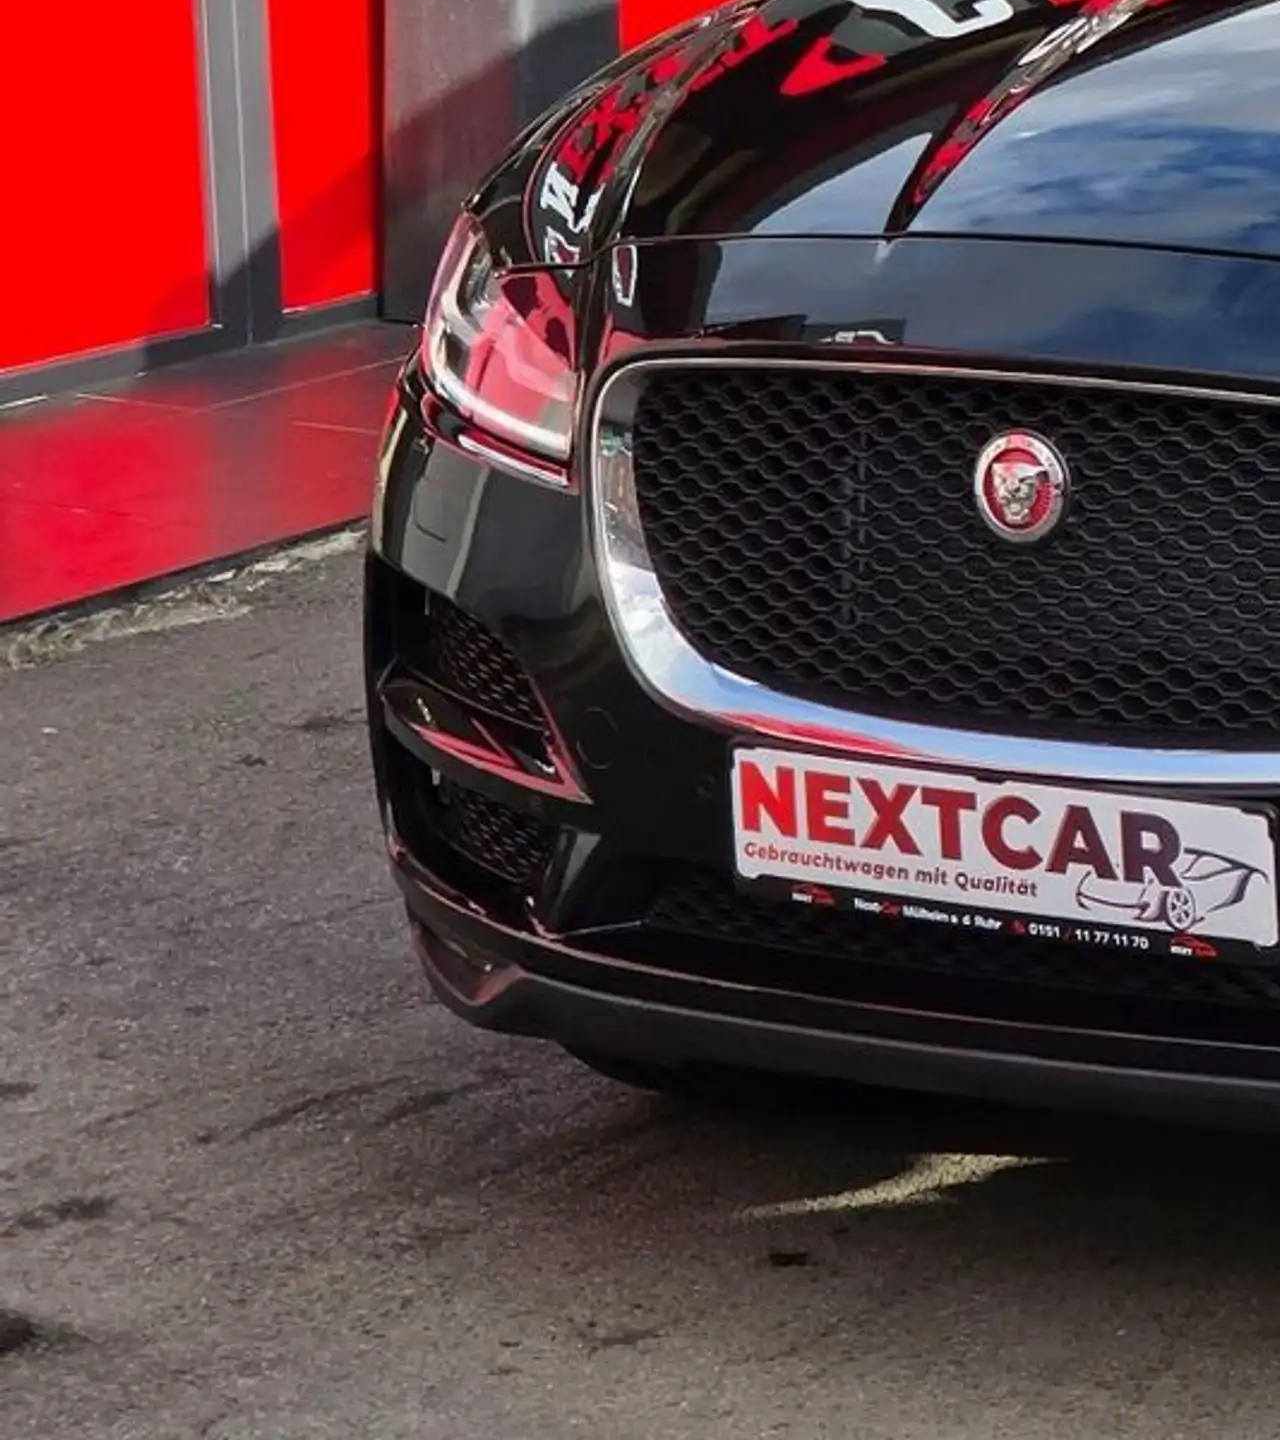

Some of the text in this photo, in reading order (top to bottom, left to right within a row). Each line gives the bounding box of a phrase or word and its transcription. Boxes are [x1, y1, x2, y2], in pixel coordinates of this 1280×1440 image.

[739, 760, 1184, 888] NEXTCAR
[743, 841, 1038, 898] Gebrauchtwagen mit Qualität
